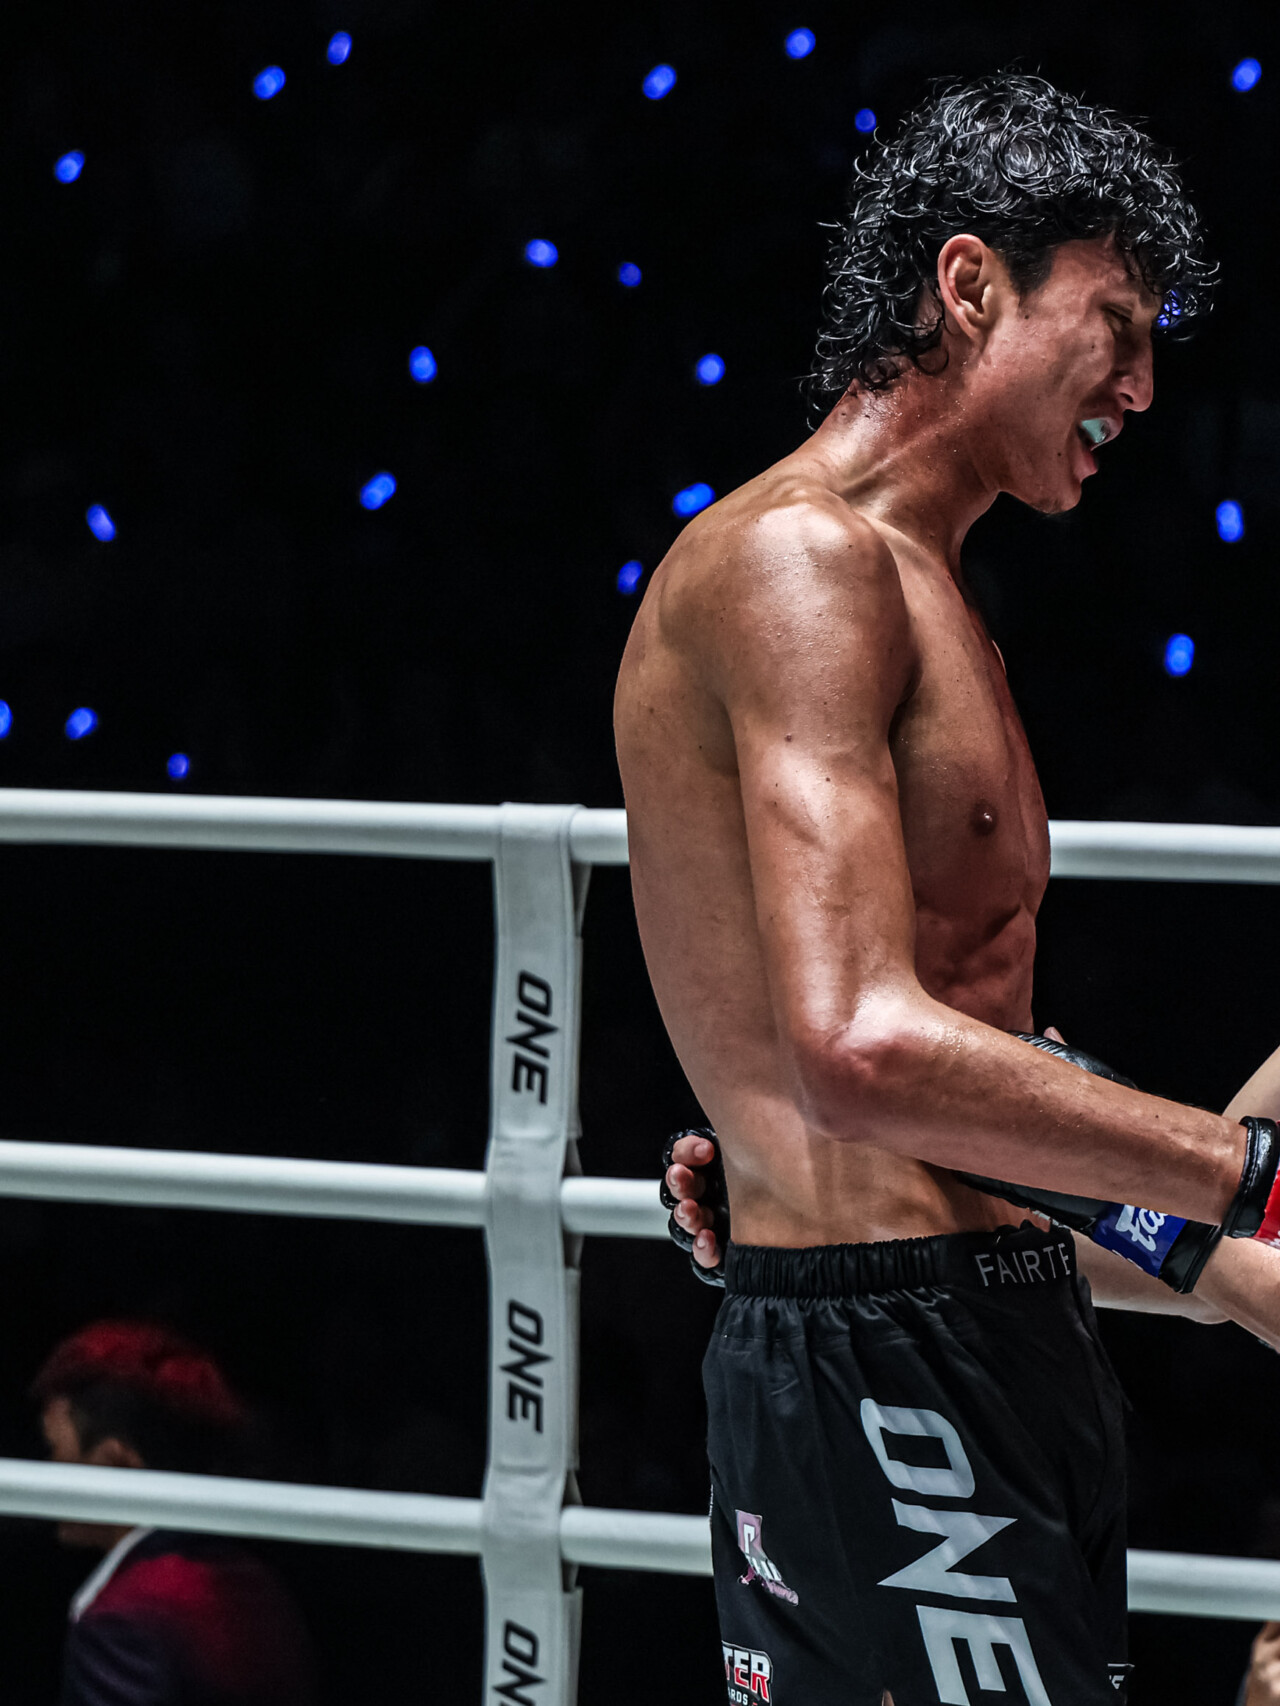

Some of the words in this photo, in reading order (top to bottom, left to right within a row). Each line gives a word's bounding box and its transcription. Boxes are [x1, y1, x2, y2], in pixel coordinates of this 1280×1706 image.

[505, 969, 559, 1105] ONE
[499, 1299, 554, 1434] ONE
[860, 1398, 1052, 1706] ONE
[492, 1618, 546, 1706] ON
